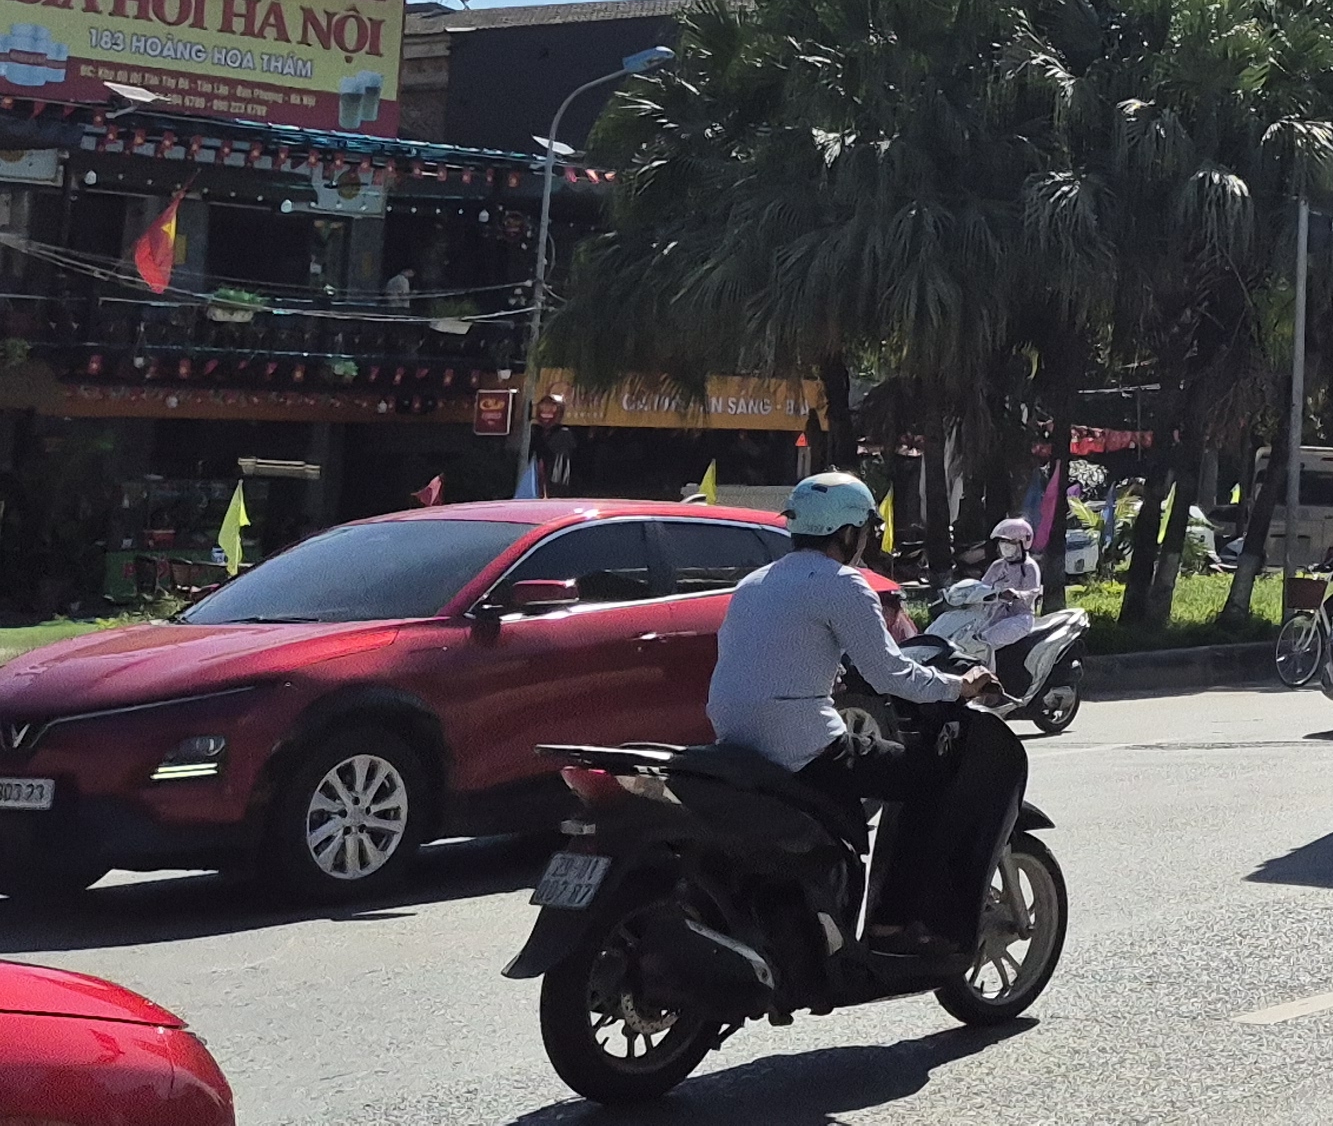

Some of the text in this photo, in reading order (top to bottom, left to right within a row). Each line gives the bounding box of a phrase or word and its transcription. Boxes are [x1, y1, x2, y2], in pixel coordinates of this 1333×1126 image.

[88, 27, 314, 79] 183 HOÀNG HOA THÁM
[297, 3, 386, 64] NỘI
[727, 388, 773, 415] SÁNG
